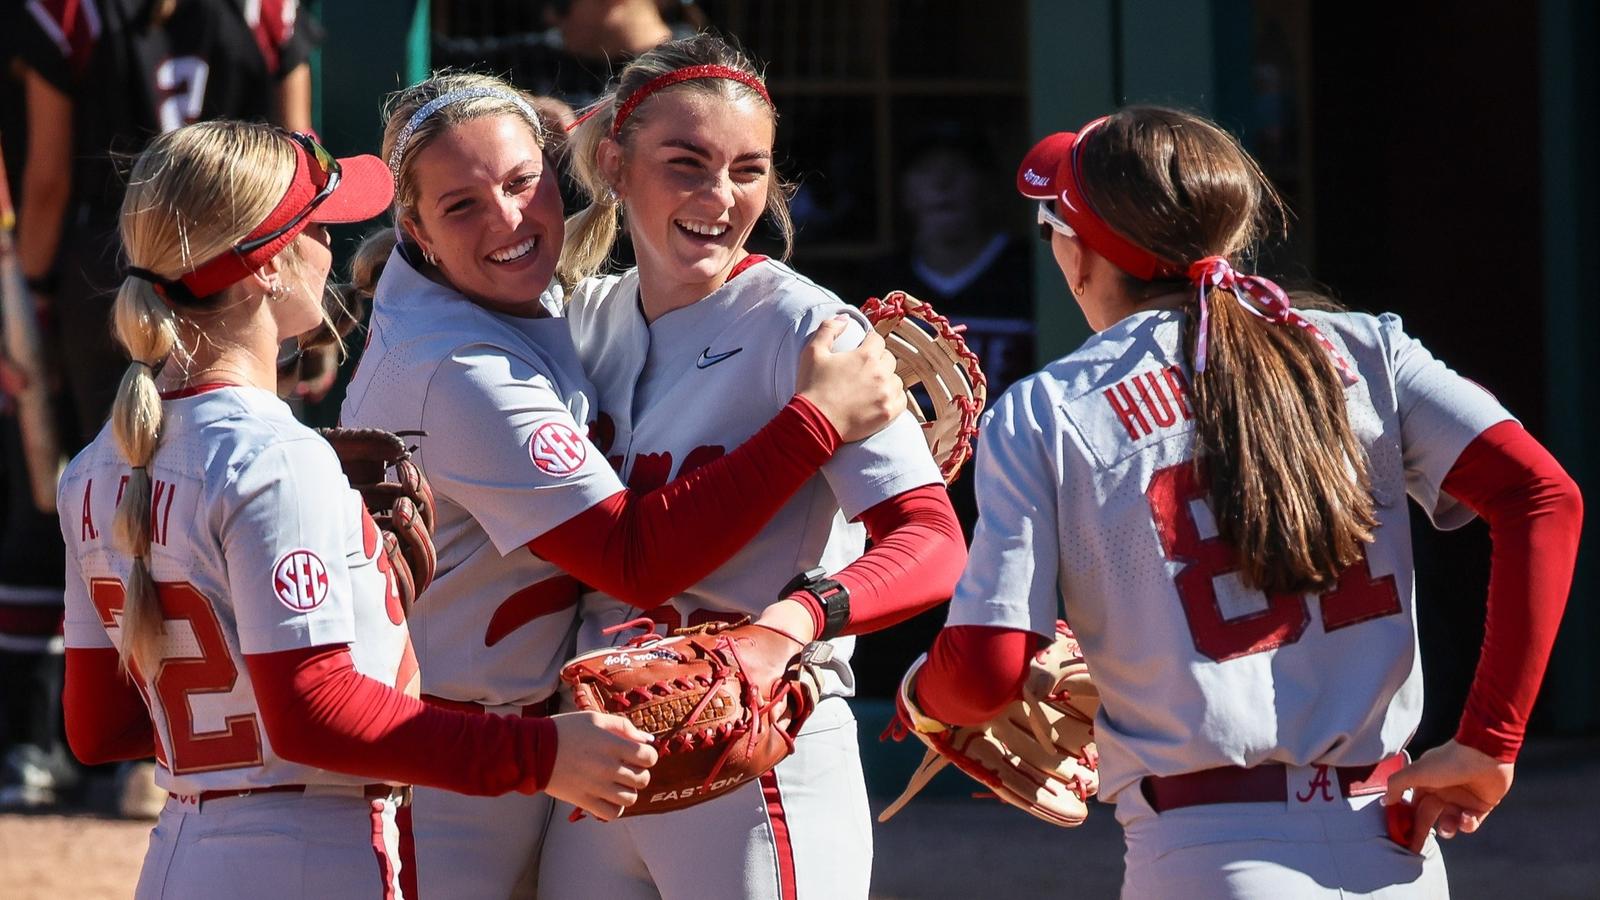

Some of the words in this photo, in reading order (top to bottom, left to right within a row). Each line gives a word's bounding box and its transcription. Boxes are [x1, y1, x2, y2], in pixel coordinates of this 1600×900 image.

[531, 423, 586, 474] SEC
[82, 478, 99, 542] A.
[274, 550, 328, 610] SEC
[1296, 763, 1334, 802] A
